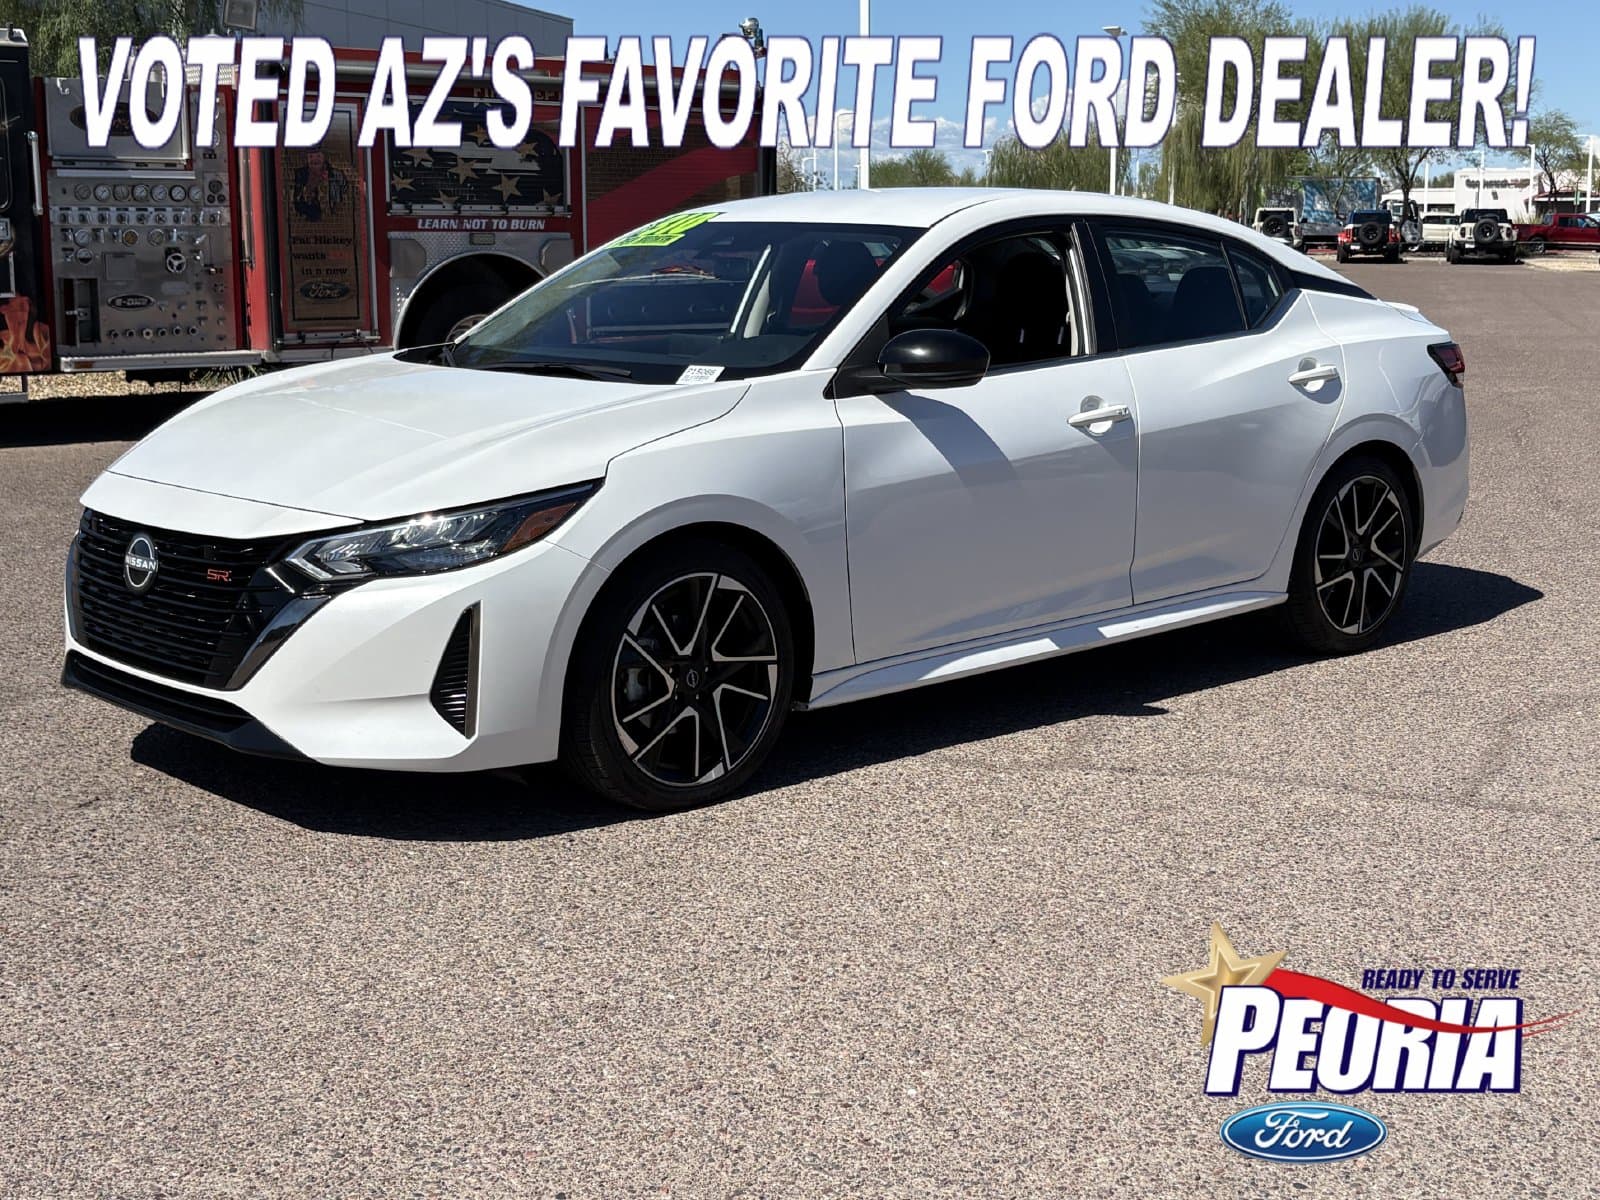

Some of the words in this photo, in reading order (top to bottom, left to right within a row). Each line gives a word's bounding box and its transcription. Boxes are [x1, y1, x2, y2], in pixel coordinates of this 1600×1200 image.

[418, 218, 458, 229] LEARN
[462, 218, 490, 229] NOT
[492, 219, 508, 230] TO
[510, 219, 546, 230] BURN
[125, 554, 157, 570] NISSAN
[207, 568, 230, 582] SR
